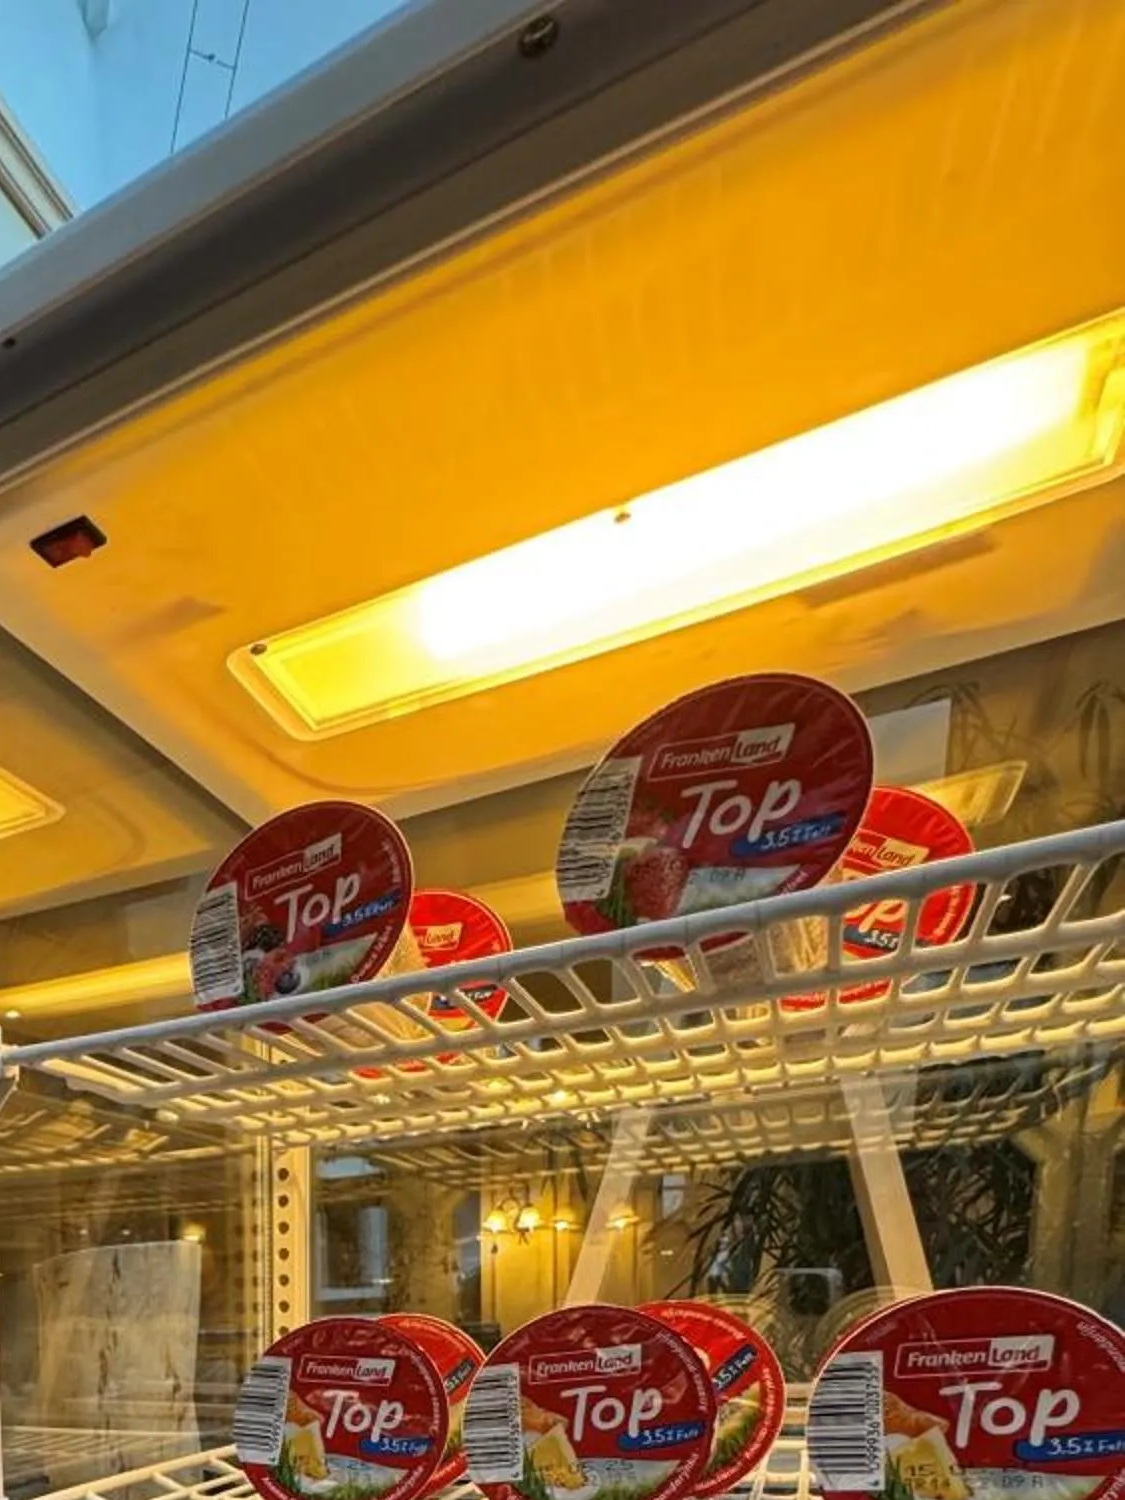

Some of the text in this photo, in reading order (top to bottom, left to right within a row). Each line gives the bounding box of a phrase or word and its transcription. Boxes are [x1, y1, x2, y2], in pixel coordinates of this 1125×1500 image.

[681, 778, 801, 849] Top
[275, 873, 360, 943] Top
[320, 1389, 404, 1442] Top
[561, 1385, 662, 1442] Top
[939, 1381, 1079, 1449] Top
